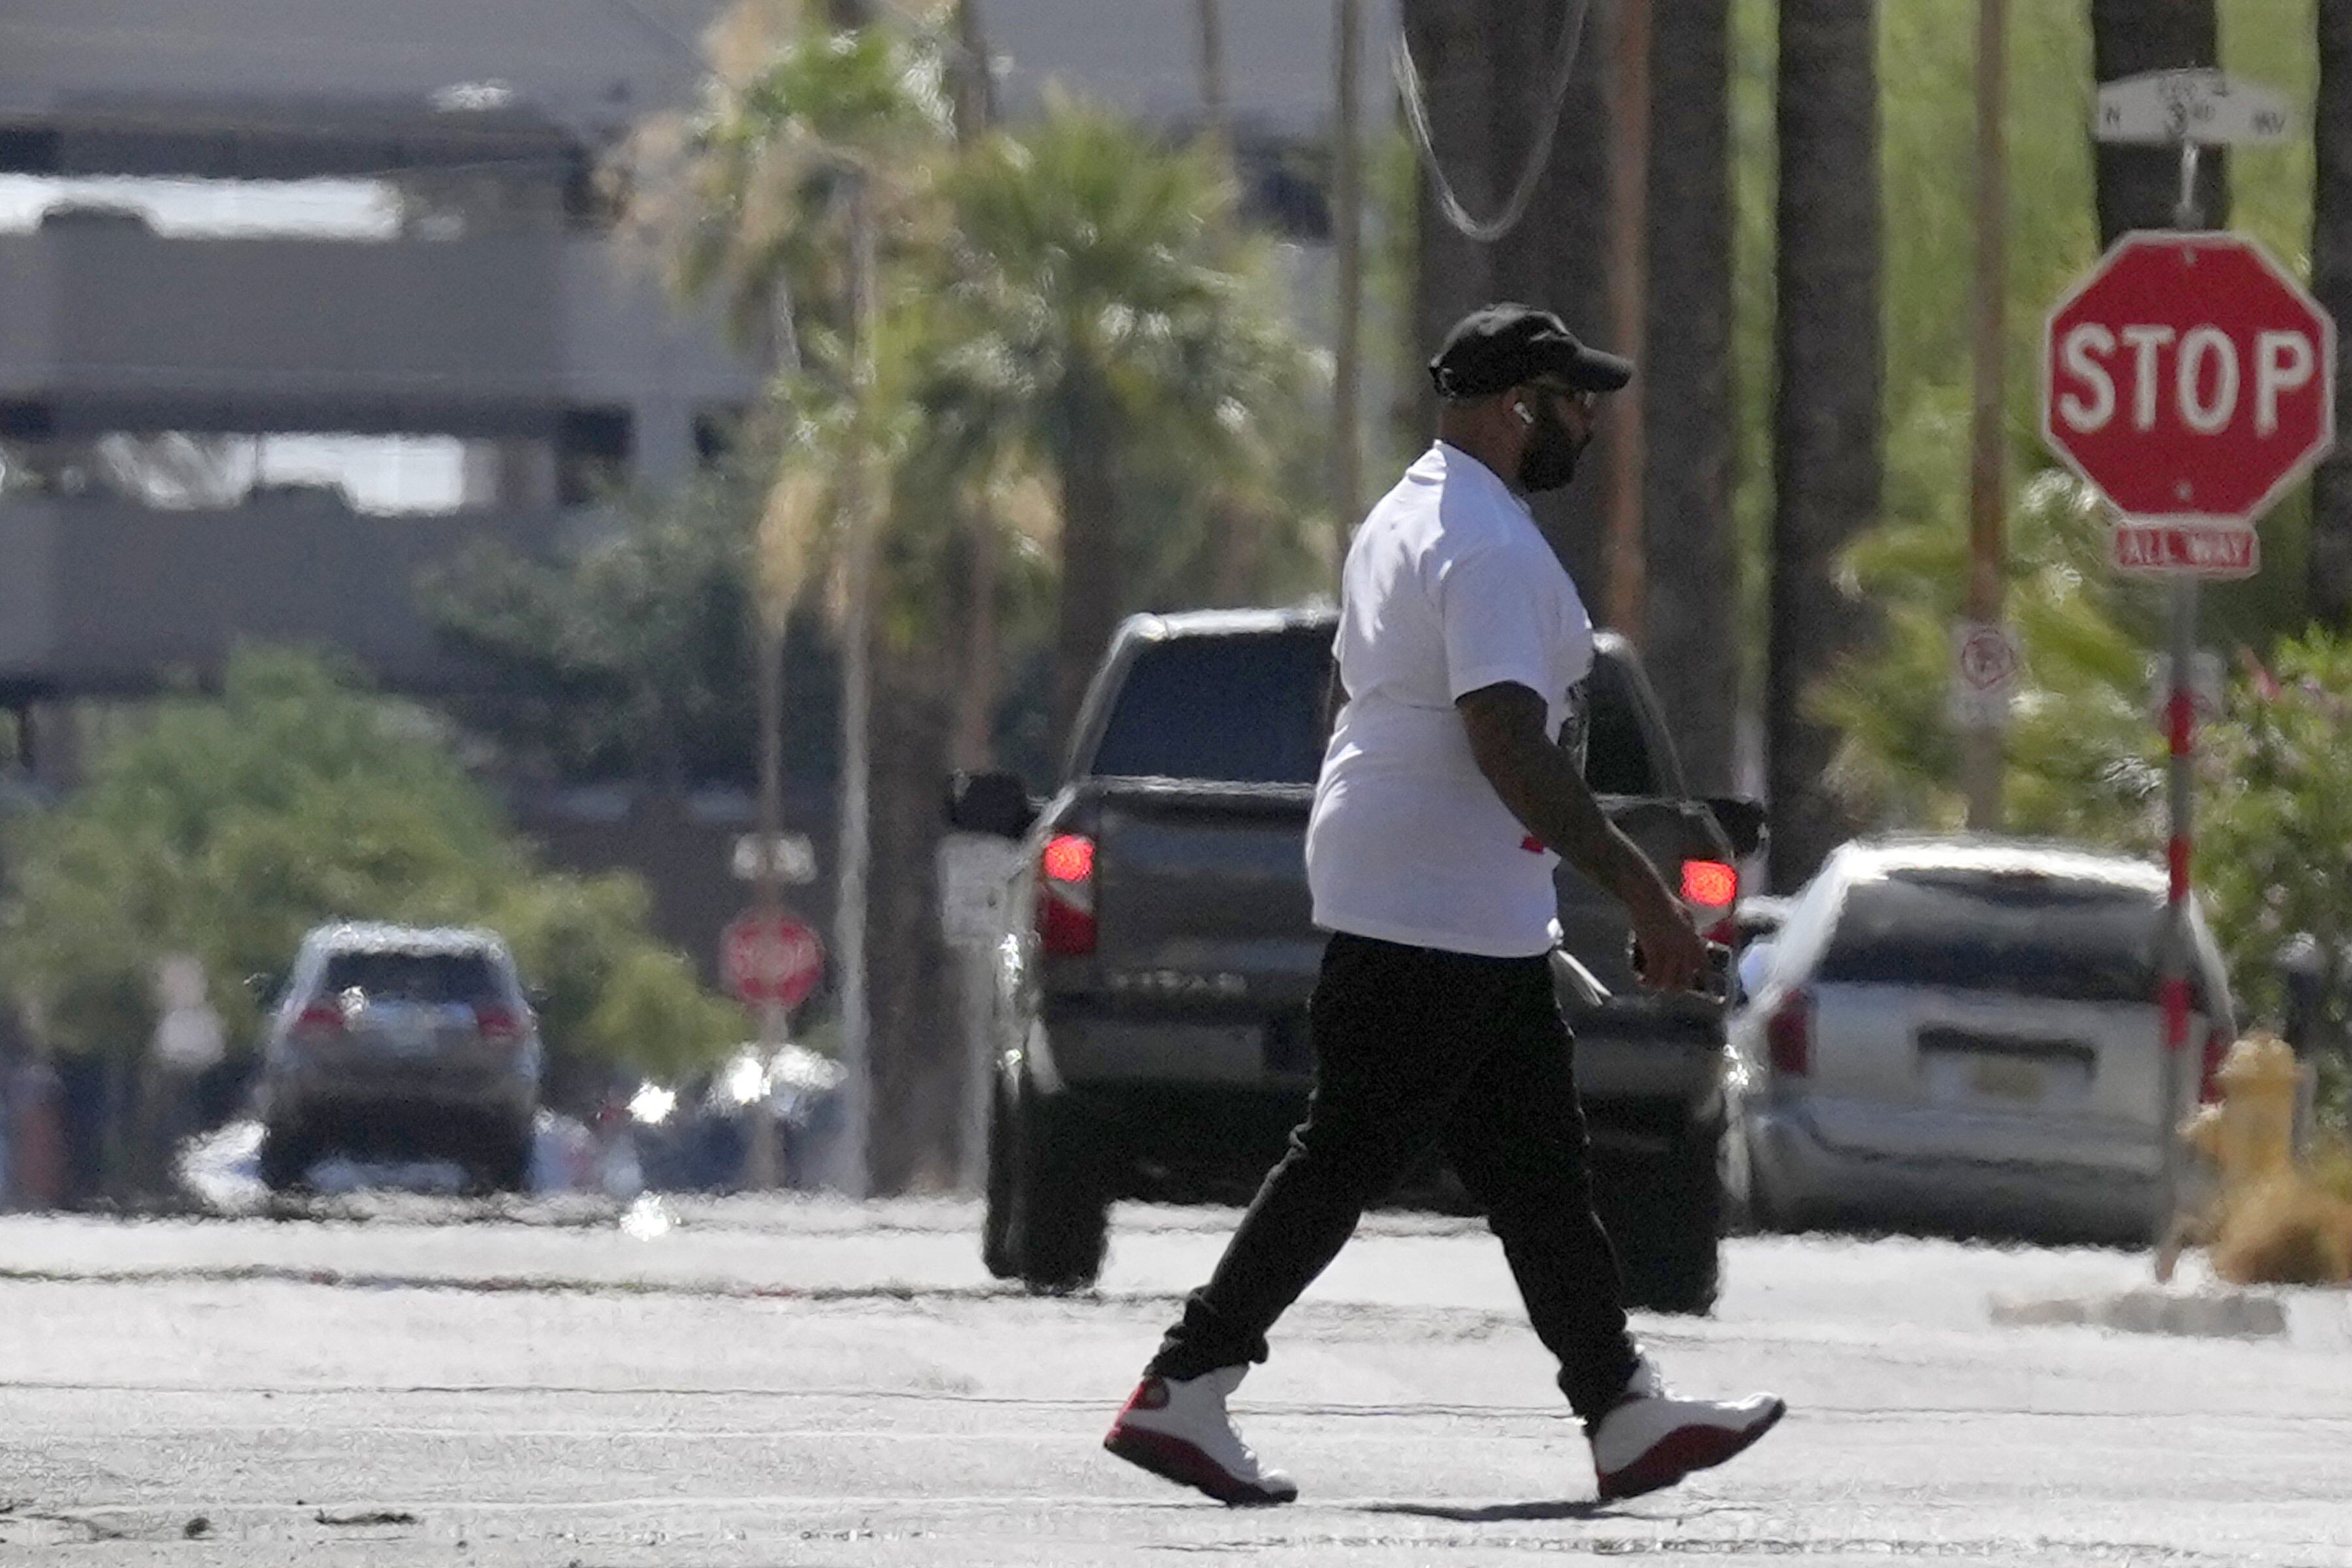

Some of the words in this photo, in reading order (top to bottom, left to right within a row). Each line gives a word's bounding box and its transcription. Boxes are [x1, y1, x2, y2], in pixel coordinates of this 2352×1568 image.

[2059, 322, 2315, 439] STOP
[2122, 528, 2178, 566] ALL
[2185, 528, 2250, 566] WAY
